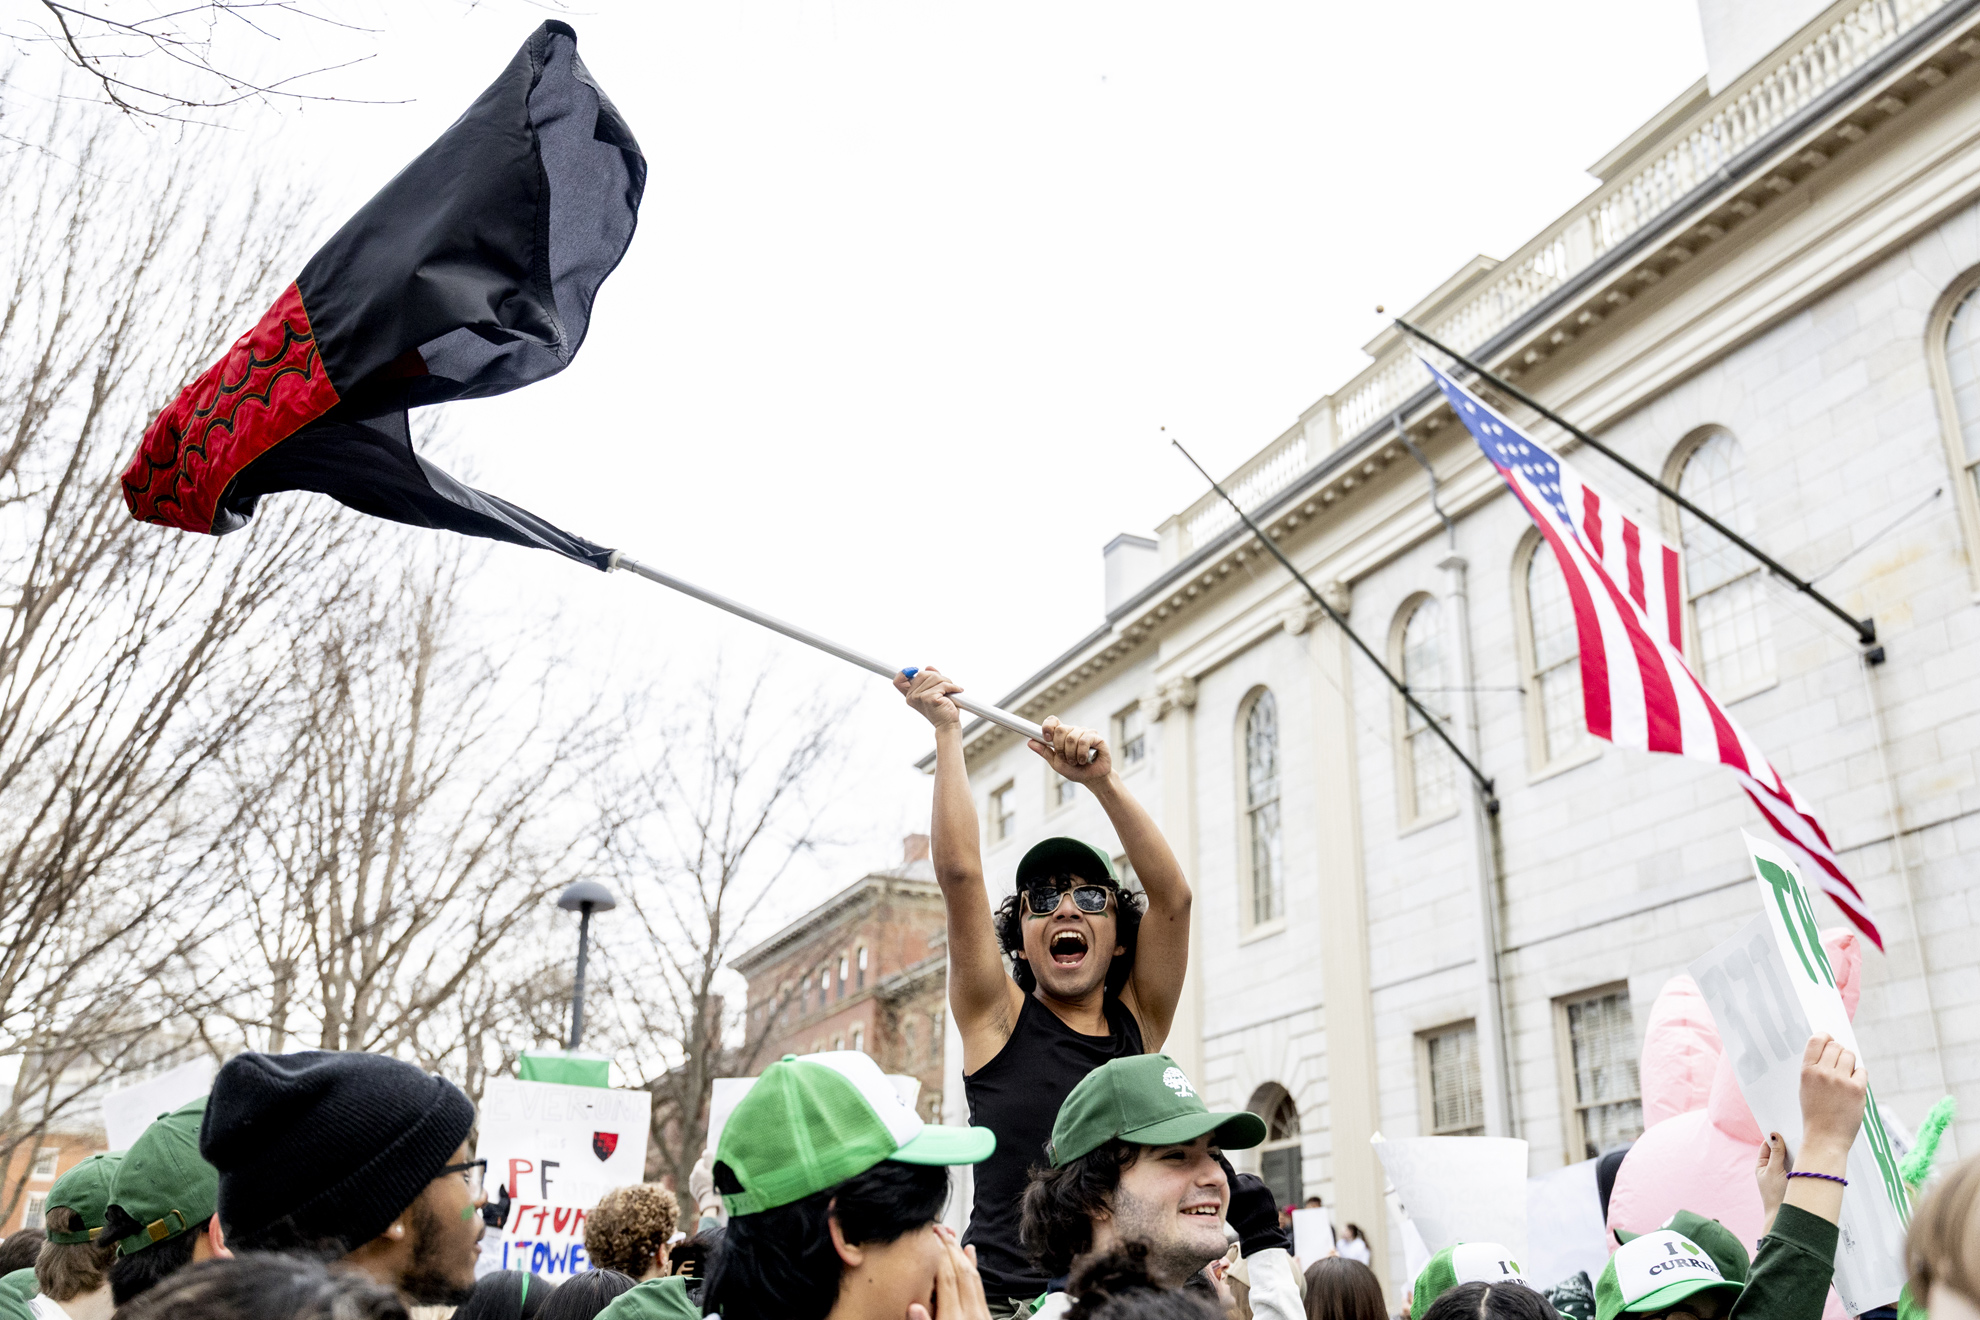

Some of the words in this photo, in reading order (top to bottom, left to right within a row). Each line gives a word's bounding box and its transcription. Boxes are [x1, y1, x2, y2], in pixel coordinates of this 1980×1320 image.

[1664, 1242, 1678, 1255] I
[515, 1241, 594, 1275] TOWE
[1498, 1261, 1509, 1274] I
[1649, 1258, 1722, 1276] CURRIE
